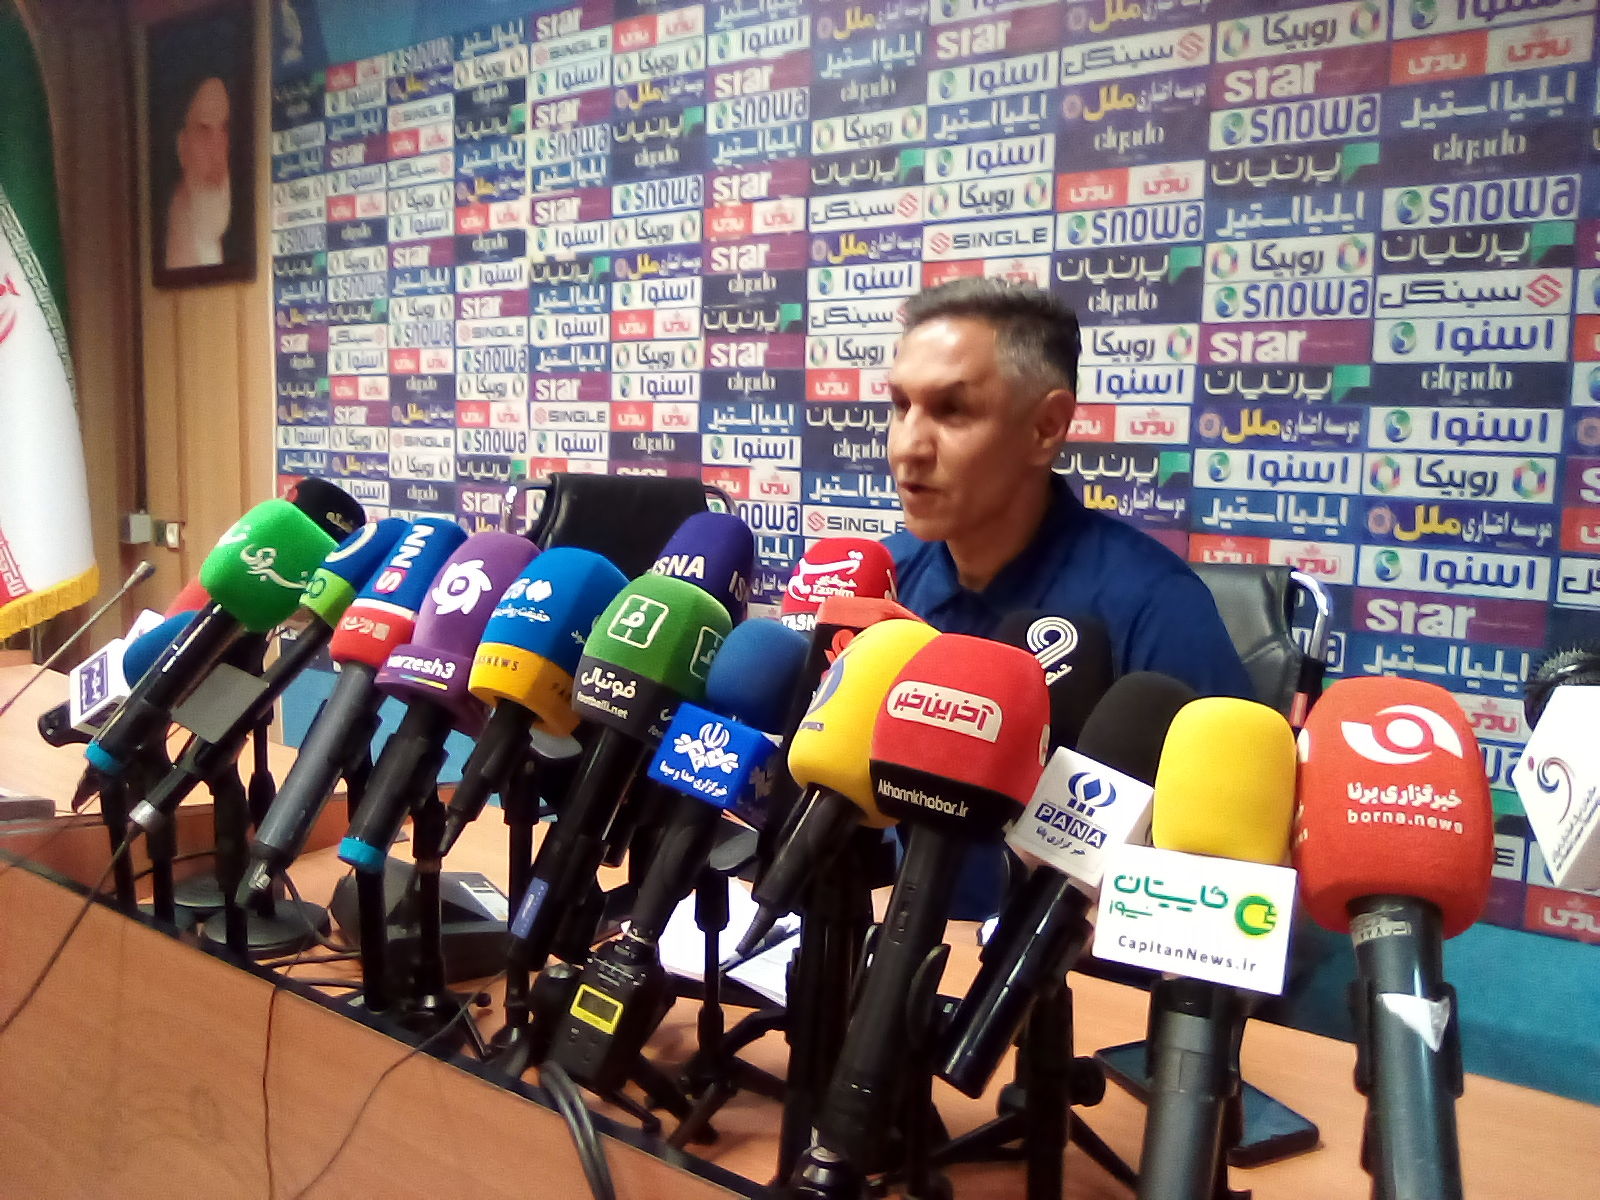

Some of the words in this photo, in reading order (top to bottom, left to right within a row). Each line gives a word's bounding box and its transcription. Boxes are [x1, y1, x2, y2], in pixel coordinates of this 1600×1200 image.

[741, 18, 801, 54] اسنوا
[936, 20, 1012, 59] star
[1263, 14, 1337, 50] روبیکا
[714, 64, 774, 98] star
[969, 53, 1049, 95] اسنوا
[1224, 61, 1322, 102] star
[1001, 93, 1047, 134] ایلیا
[1083, 84, 1136, 121] ملل
[1400, 81, 1498, 129] استیل
[1503, 71, 1576, 121] ایلیا
[843, 115, 892, 148] روبیکا
[933, 100, 999, 141] استیل
[1250, 96, 1377, 143] snowa
[967, 135, 1046, 175] اسنوا
[1212, 152, 1342, 187] پرنیان
[713, 171, 772, 201] star
[959, 182, 1014, 214] روبیکا
[1429, 177, 1577, 224] snowa
[1091, 204, 1201, 245] snowa
[1216, 195, 1299, 239] استیل
[1303, 191, 1364, 233] ایلیا
[828, 232, 868, 264] ملل
[952, 226, 1048, 249] SINGLE
[1382, 231, 1529, 266] پرنیان
[627, 253, 660, 280] ملل
[710, 244, 771, 271] star
[1057, 254, 1169, 284] پرنیان
[1251, 242, 1324, 279] روبیکا
[642, 279, 695, 308] اسنوا
[845, 264, 913, 294] اسنوا
[1243, 279, 1369, 318] snowa
[555, 316, 604, 340] اسنوا
[1093, 329, 1154, 362] روبیکا
[1435, 319, 1554, 357] اسنوا
[637, 343, 674, 370] روبیکا
[710, 342, 769, 367] star
[836, 336, 884, 366] روبیکا
[1209, 330, 1306, 363] star
[535, 378, 582, 401] star
[640, 374, 693, 400] اسنوا
[1096, 367, 1184, 400] اسنوا
[1204, 370, 1332, 403] پرنیان
[707, 403, 757, 432] استیل
[758, 403, 794, 433] ایلیا
[1222, 408, 1280, 444] ملل
[1431, 410, 1548, 447] اسنوا
[474, 428, 527, 454] snowa
[555, 432, 602, 456] اسنوا
[734, 437, 793, 462] اسنوا
[1248, 453, 1348, 488] اسنوا
[1415, 457, 1498, 497] روبیکا
[462, 491, 503, 514] star
[808, 474, 865, 503] استیل
[1202, 493, 1285, 529] استیل
[1287, 495, 1348, 536] ایلیا
[1394, 505, 1460, 541] ملل
[375, 524, 436, 593] SNN
[650, 553, 706, 579] SNA
[1420, 553, 1536, 590] اسنوا
[1366, 599, 1476, 639] star
[387, 654, 456, 679] zesh3
[1363, 645, 1458, 676] استیل
[1461, 645, 1529, 693] ایلیا
[581, 666, 637, 699] فوتبالی
[893, 688, 926, 711] خبر
[922, 693, 995, 731] آخرین
[1036, 804, 1105, 848] PANA
[1347, 808, 1464, 835] borna.news
[1114, 874, 1229, 912] کاپیتان
[1118, 935, 1257, 971] CapitanNews.ir
